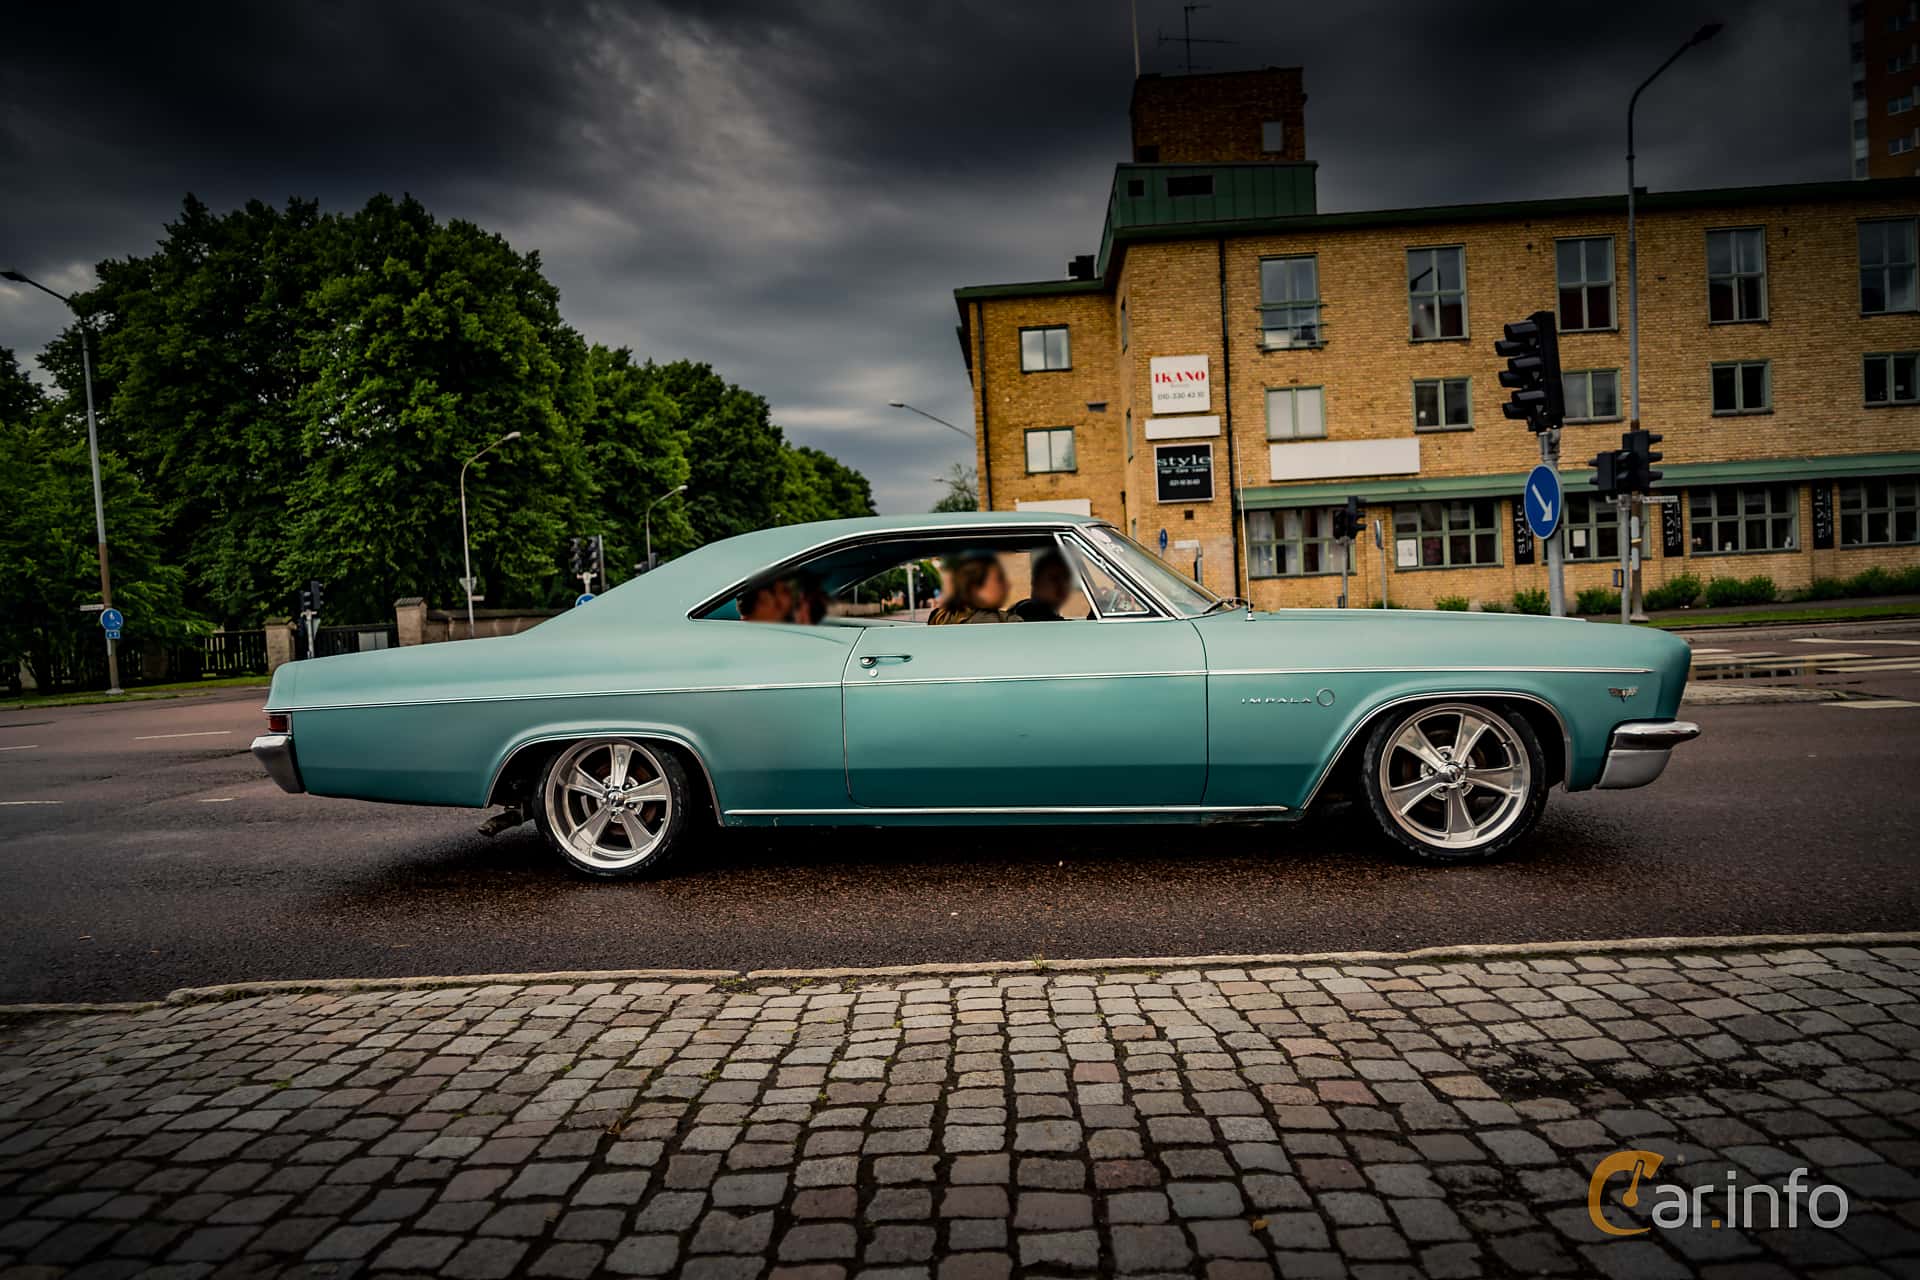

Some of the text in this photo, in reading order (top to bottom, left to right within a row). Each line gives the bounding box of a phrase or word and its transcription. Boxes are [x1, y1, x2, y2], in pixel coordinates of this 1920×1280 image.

[1155, 370, 1206, 383] IKANO
[1157, 454, 1211, 468] style
[1514, 504, 1526, 555] style
[1814, 488, 1826, 539] style
